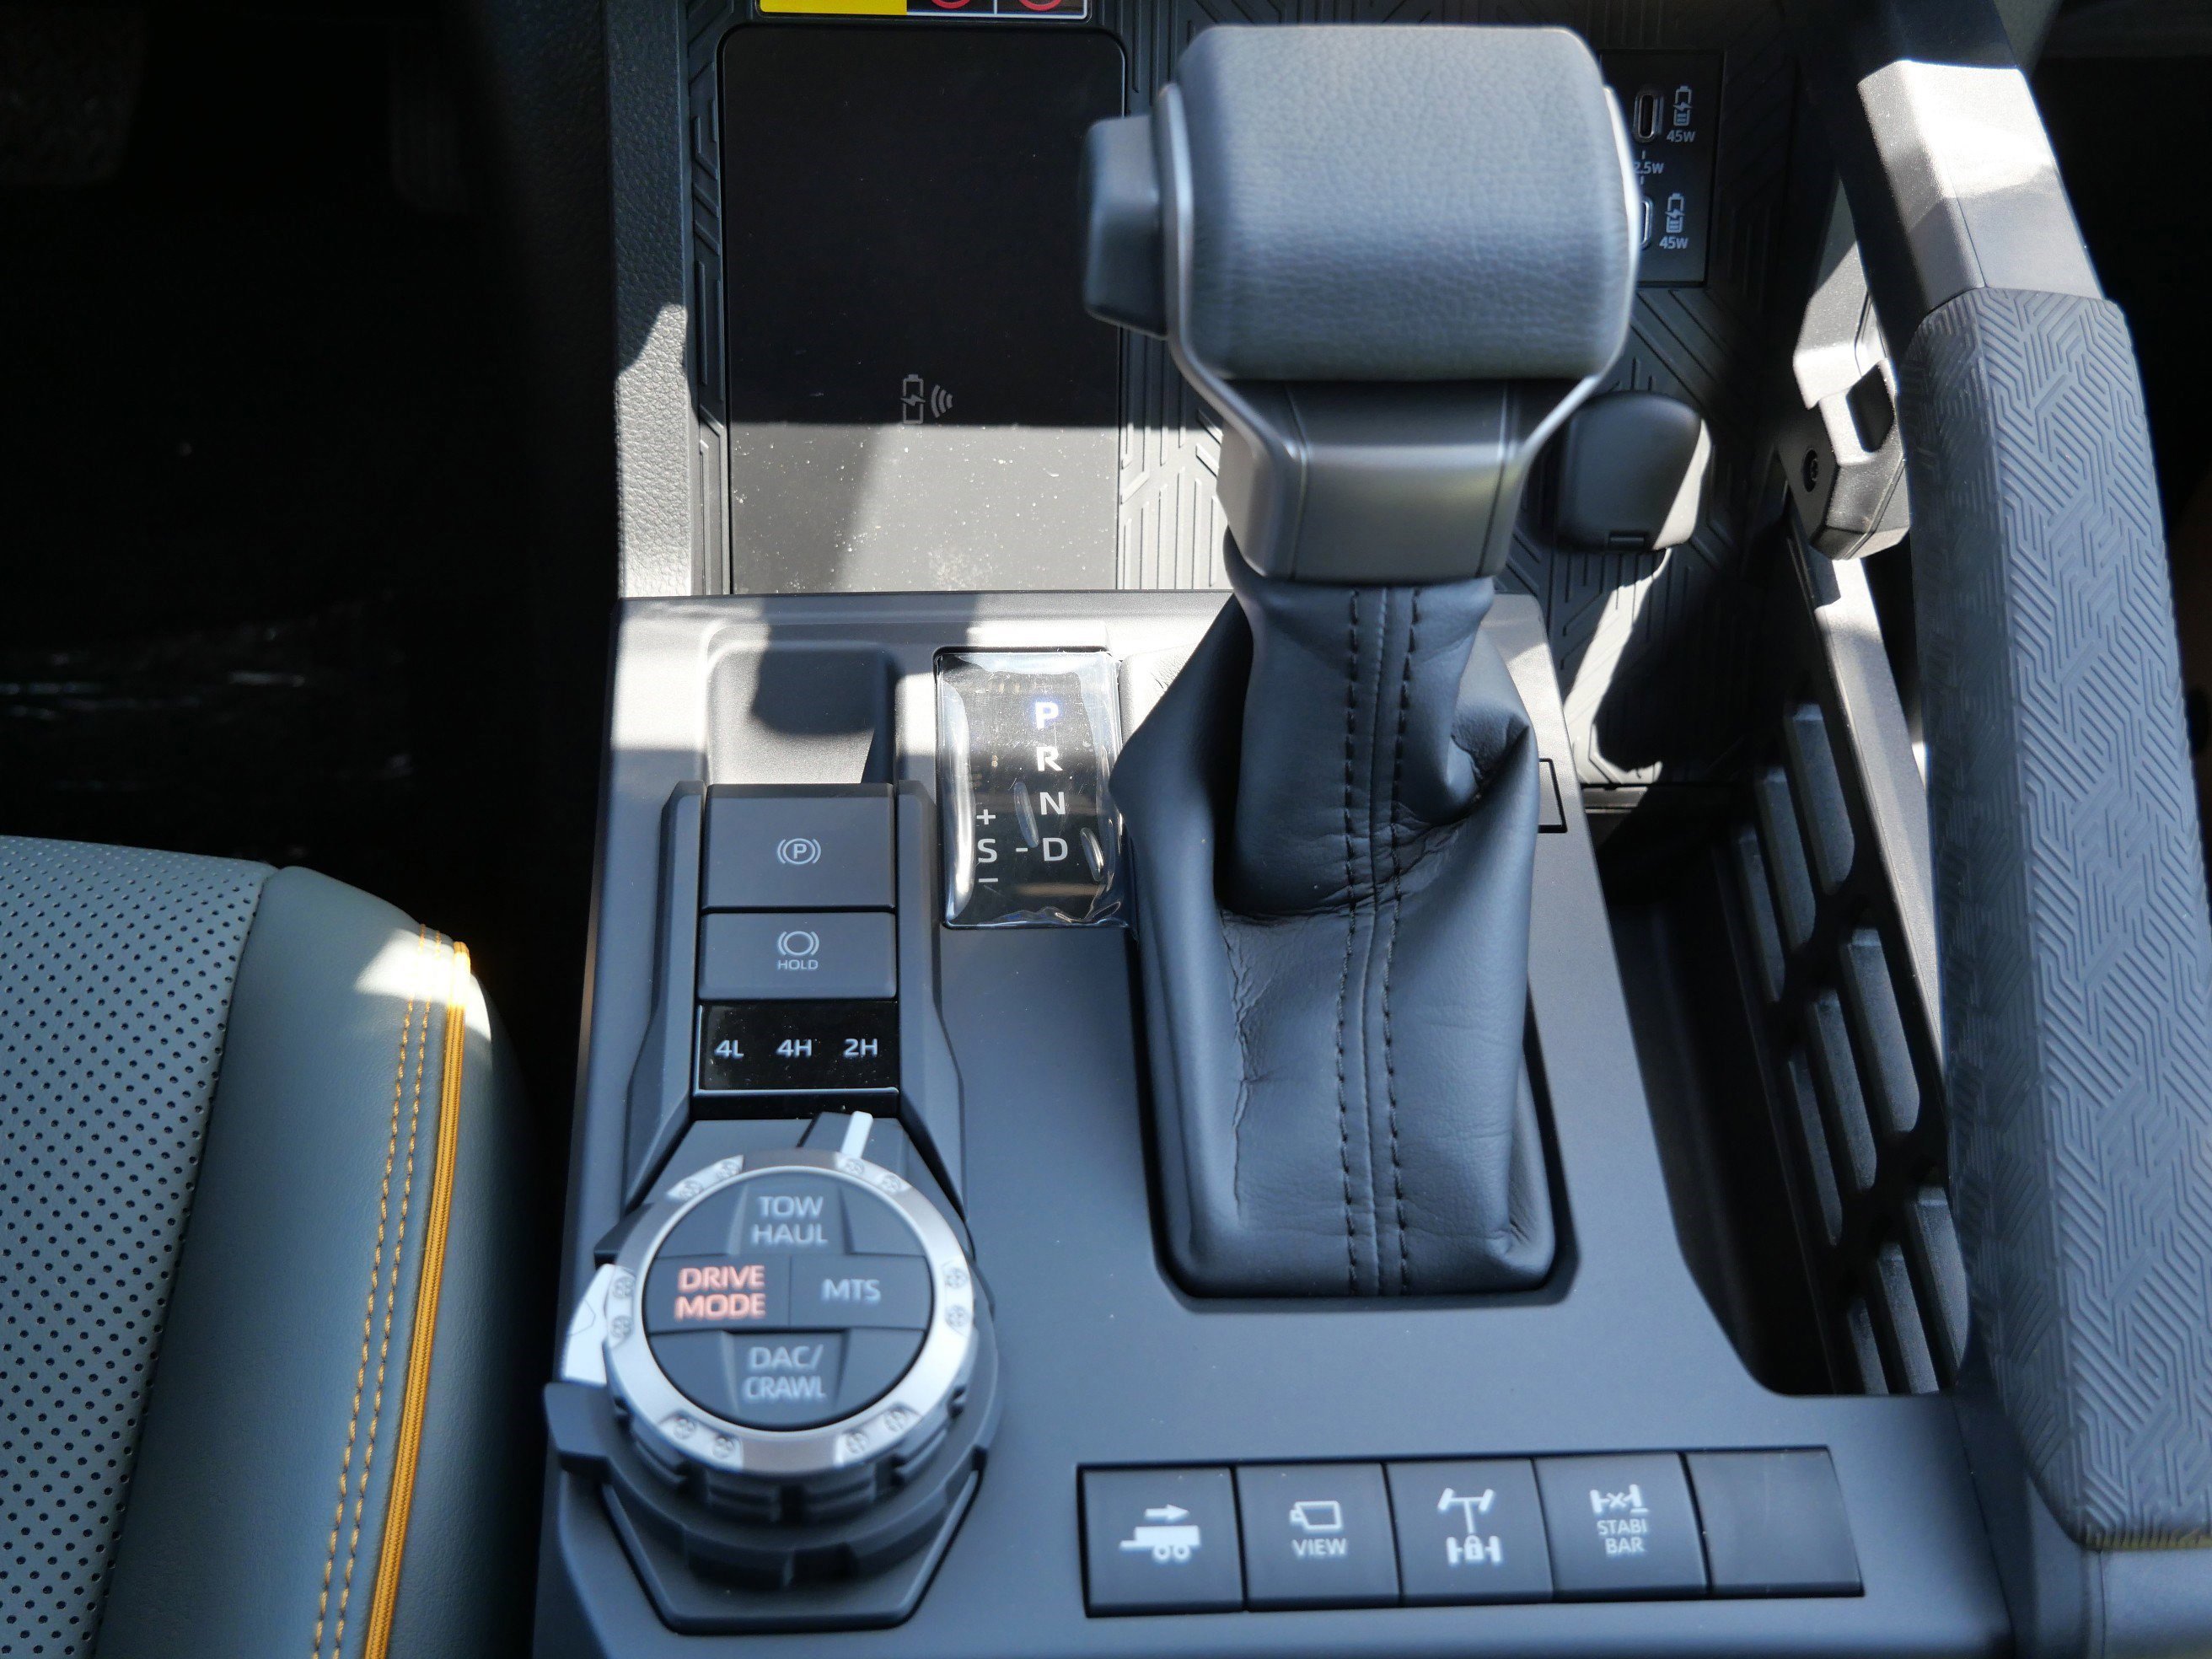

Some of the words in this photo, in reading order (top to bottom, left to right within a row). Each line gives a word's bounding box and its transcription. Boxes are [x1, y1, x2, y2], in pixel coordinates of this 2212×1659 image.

[1667, 130, 1696, 142] 45W
[1659, 237, 1689, 250] 45W
[1034, 701, 1059, 729] P
[1036, 746, 1063, 771] R
[1039, 792, 1066, 815] N
[777, 959, 819, 969] HOLD
[715, 1039, 744, 1057] 4L
[776, 1039, 813, 1057] 4H
[843, 1038, 878, 1056] 2H
[758, 1195, 824, 1218] TOW
[750, 1223, 828, 1246] HAUL
[678, 1264, 765, 1291] DRIVE
[821, 1278, 882, 1302] MTS
[674, 1292, 767, 1321] MODE
[748, 1344, 824, 1372] DAC/
[743, 1376, 827, 1402] CRAWL
[1596, 1519, 1648, 1536] STABI
[1291, 1538, 1347, 1557] VIEW
[1604, 1537, 1646, 1554] BAR
